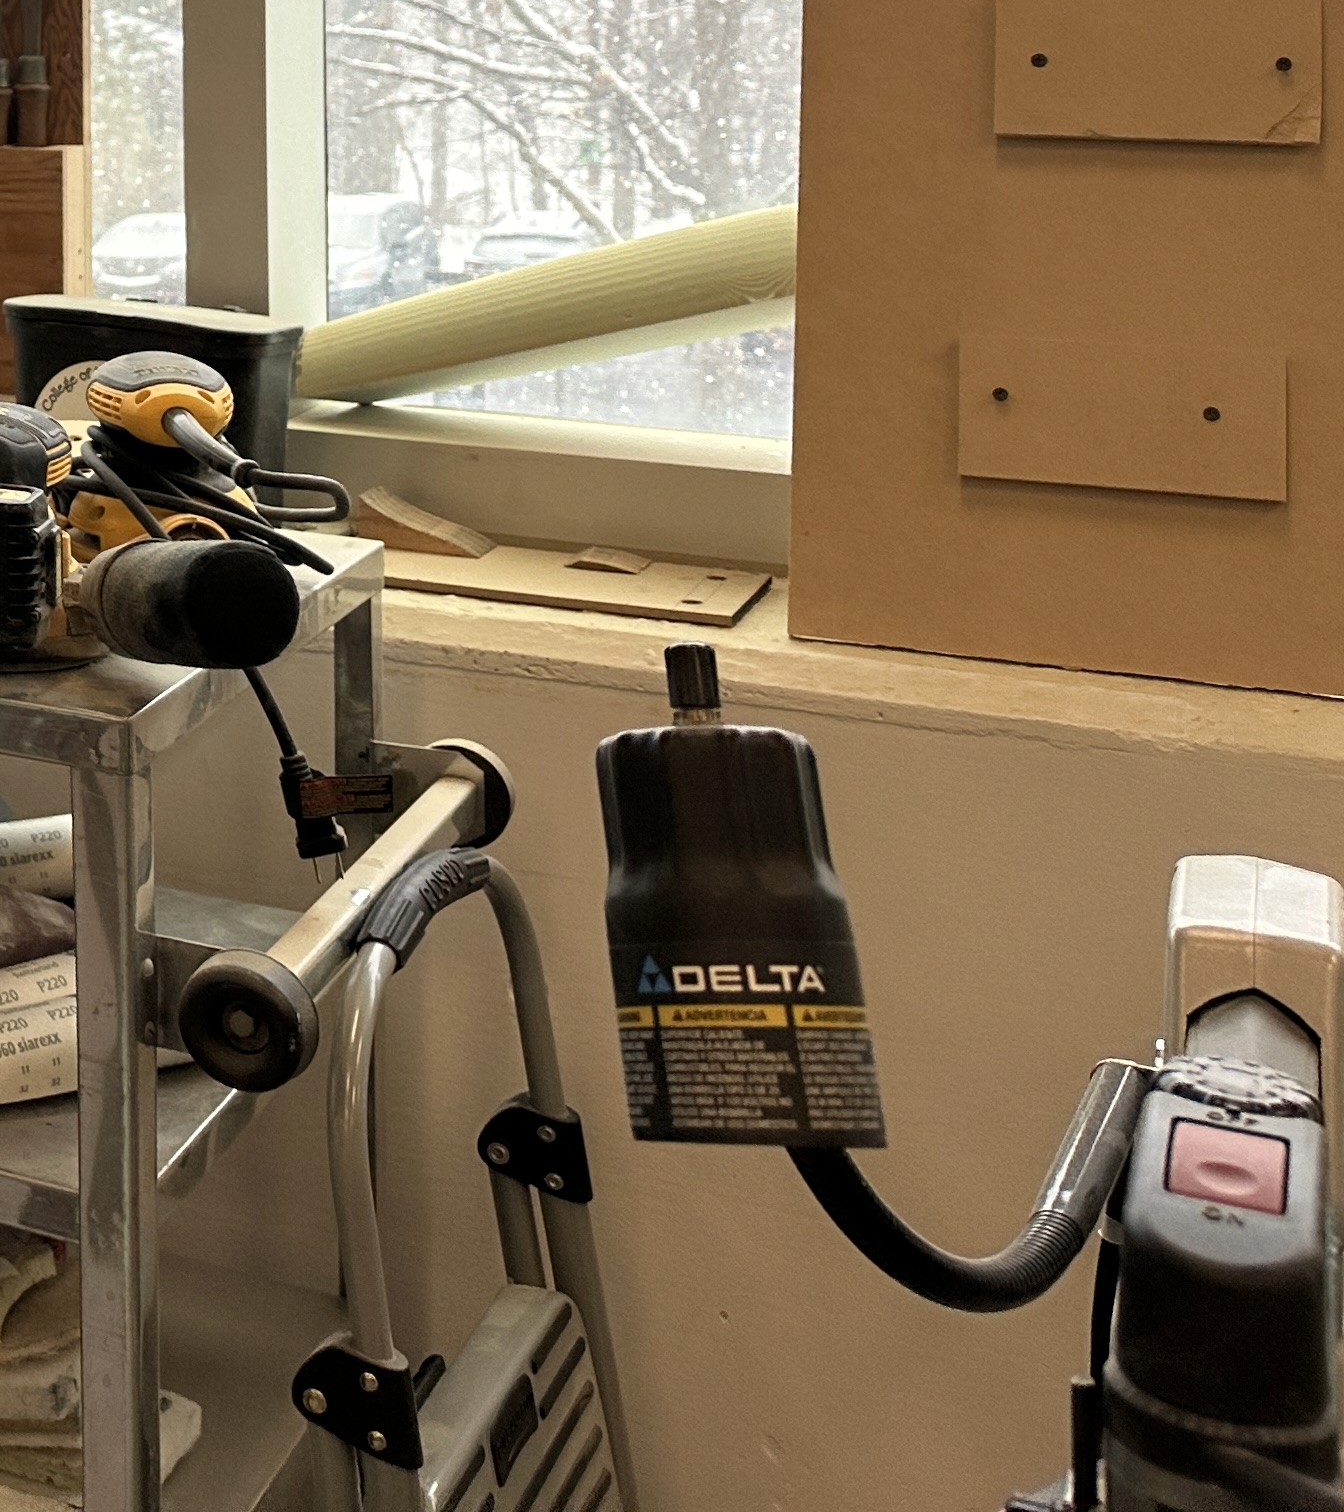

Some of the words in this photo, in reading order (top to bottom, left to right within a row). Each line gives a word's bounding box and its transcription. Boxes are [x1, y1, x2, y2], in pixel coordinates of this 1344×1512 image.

[42, 374, 78, 412] College
[30, 830, 62, 844] P220
[37, 975, 68, 993] P220
[671, 964, 826, 993] DELTA
[685, 1010, 768, 1022] ADVERTENCIA
